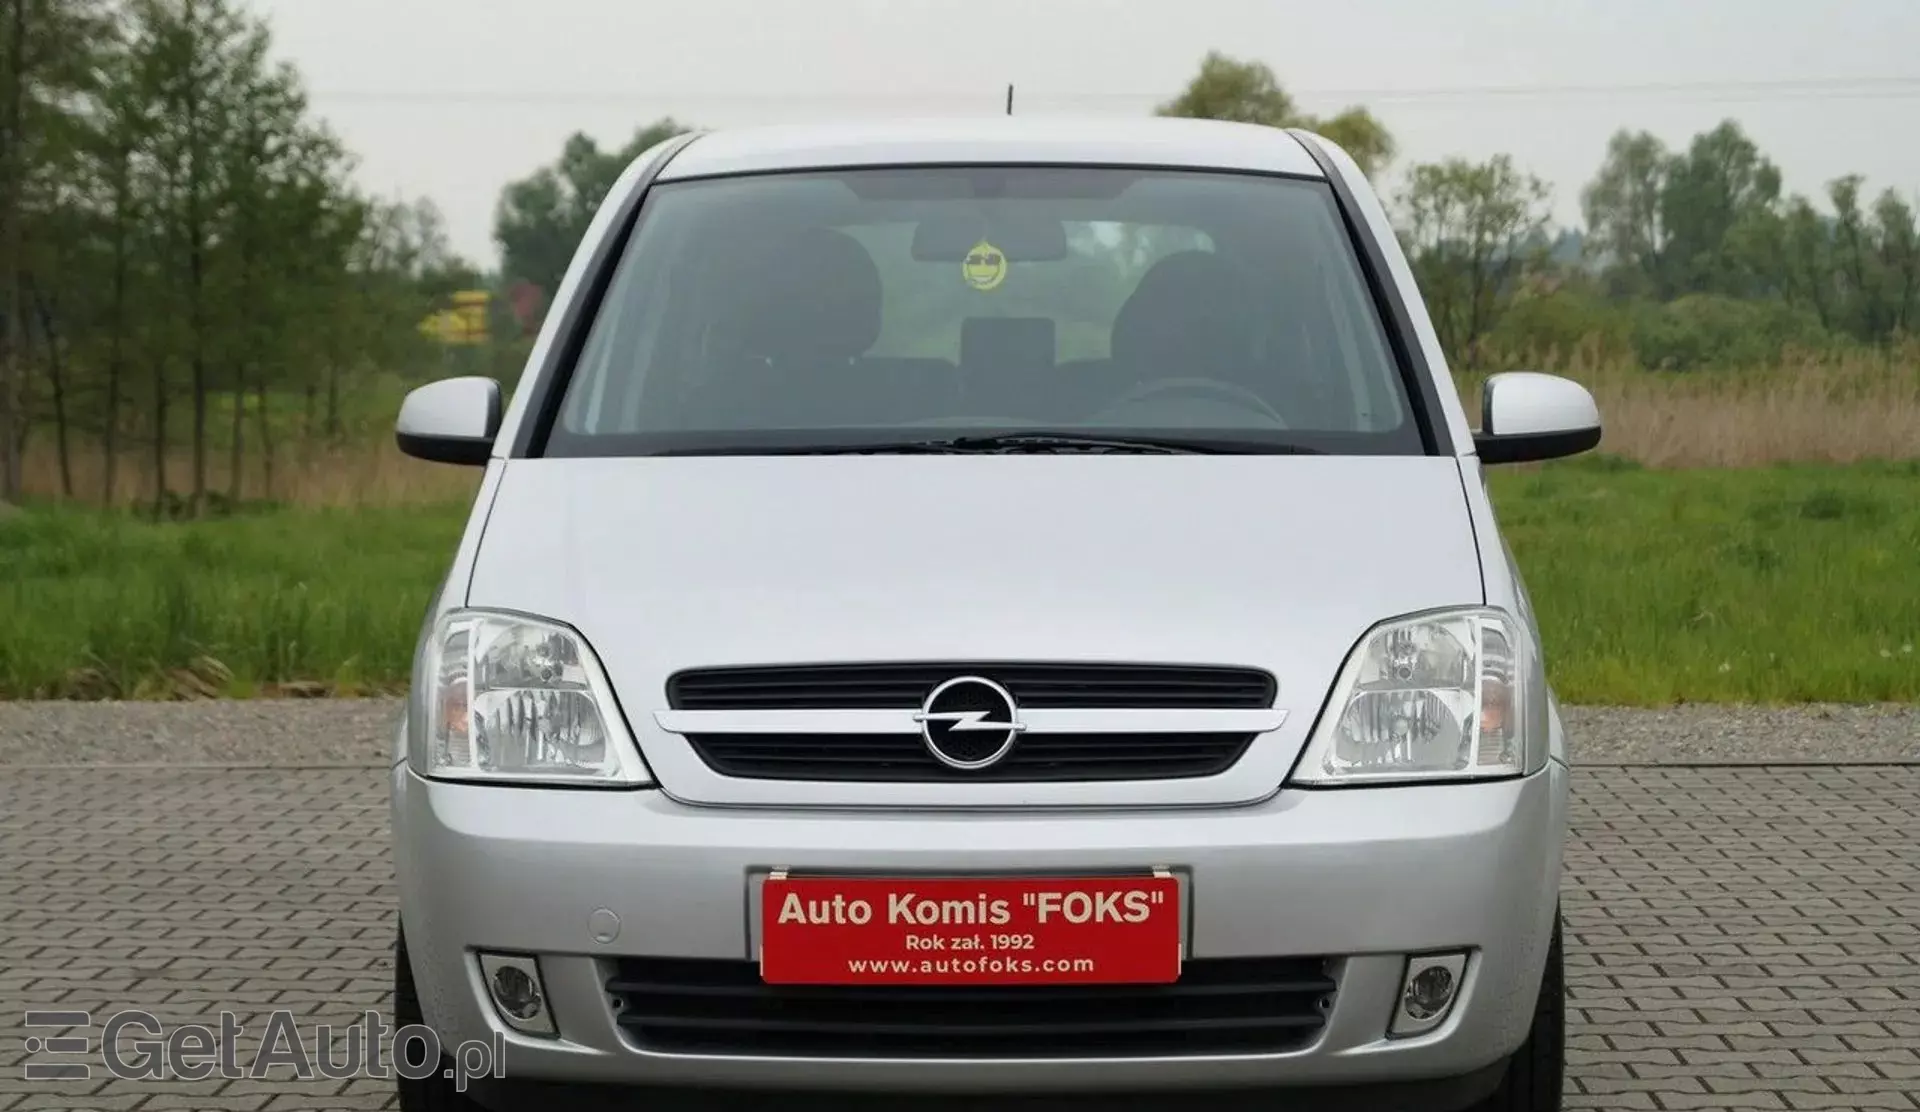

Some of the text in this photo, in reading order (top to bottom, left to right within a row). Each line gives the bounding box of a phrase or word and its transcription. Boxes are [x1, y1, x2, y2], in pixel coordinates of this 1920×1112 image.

[778, 890, 1164, 924] Auto Komis "FOKS"
[905, 933, 1035, 950] Rok zał. 1992
[848, 956, 1094, 973] www.autofoks.com
